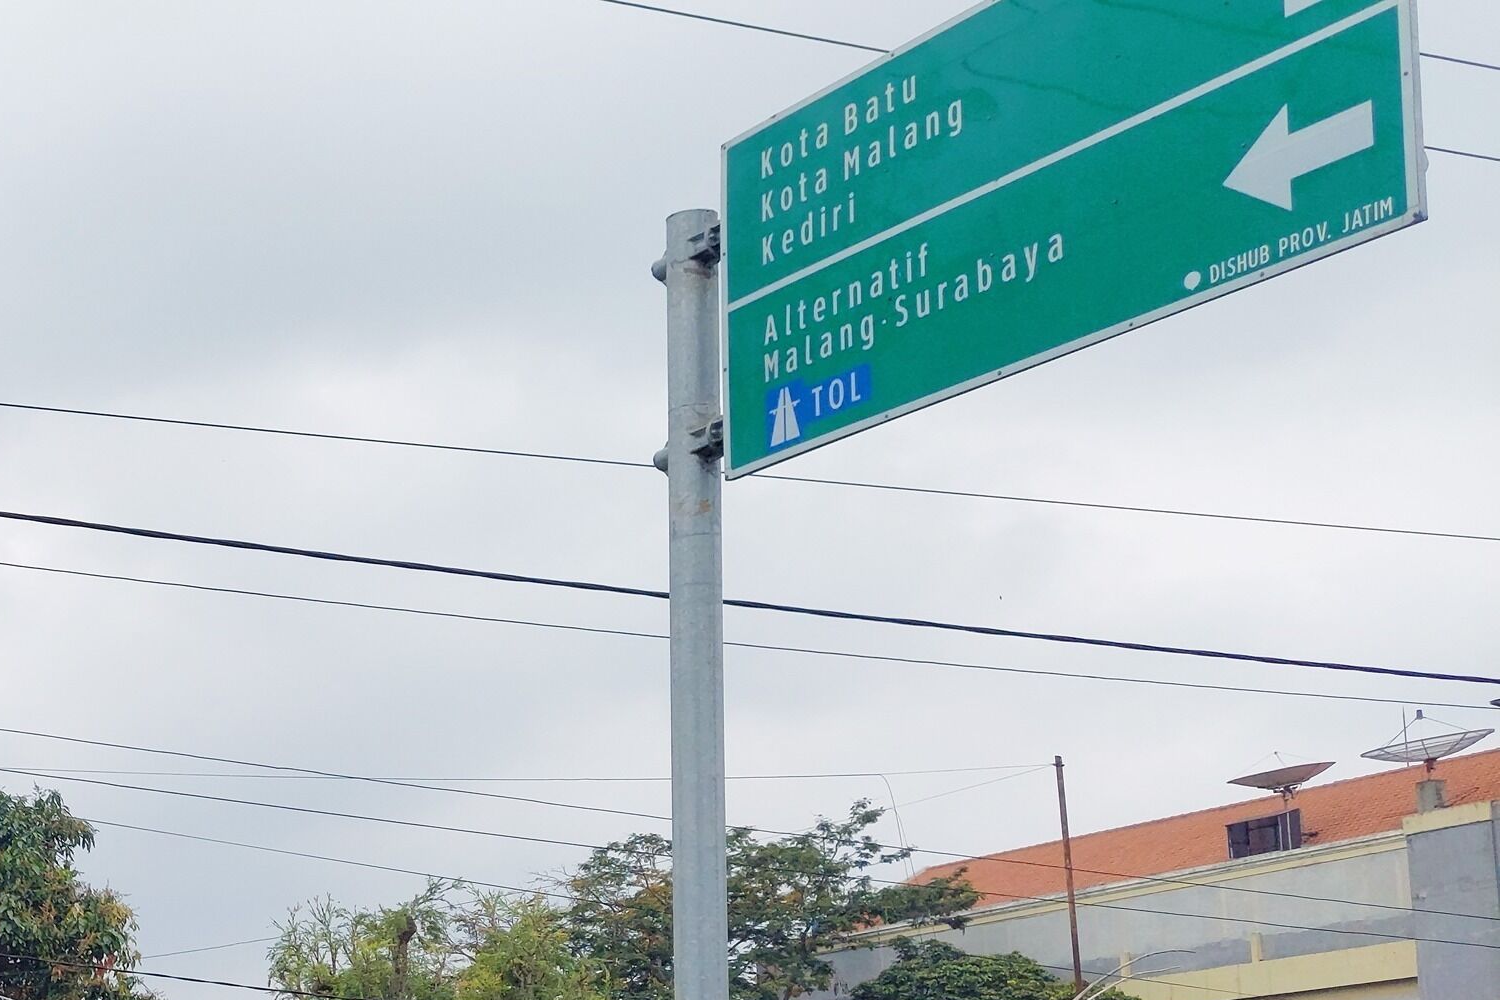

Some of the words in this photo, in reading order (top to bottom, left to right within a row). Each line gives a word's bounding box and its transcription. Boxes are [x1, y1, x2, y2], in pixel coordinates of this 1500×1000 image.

[761, 122, 828, 179] Kota
[844, 75, 916, 135] Batu
[761, 167, 827, 222] Kota
[844, 99, 962, 181] Malang
[762, 191, 855, 266] Kediri
[1209, 244, 1270, 284] DISHUB
[1279, 221, 1332, 257] PROV.
[1342, 196, 1393, 233] JATIM
[764, 242, 928, 346] Alternatif
[812, 372, 861, 417] TOL
